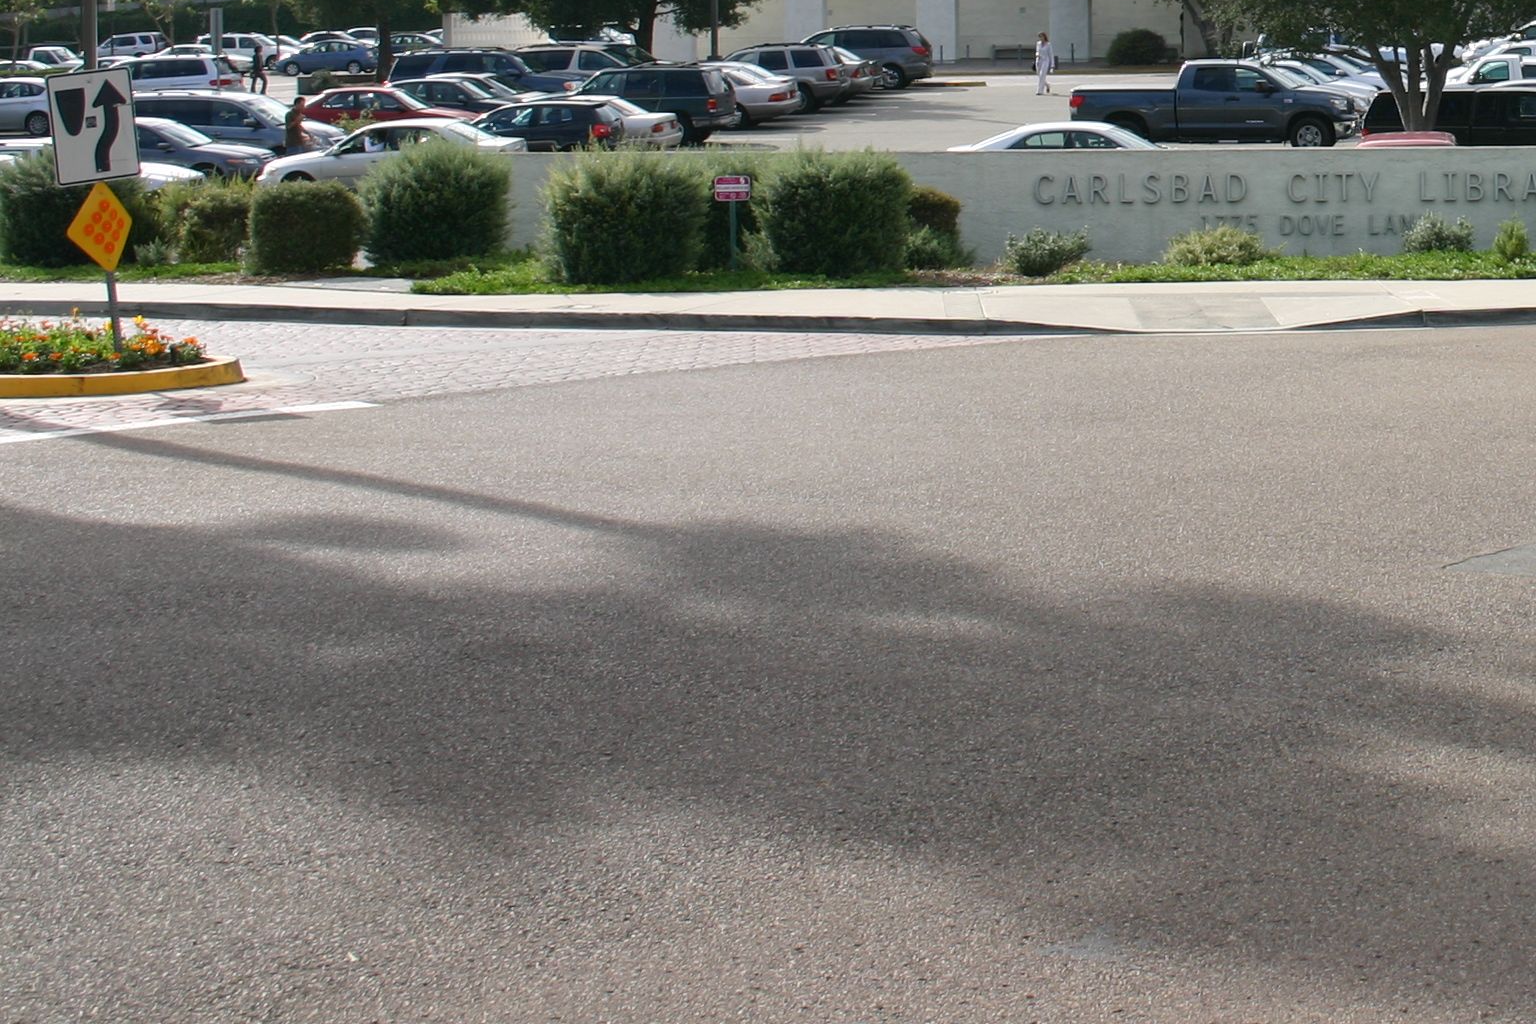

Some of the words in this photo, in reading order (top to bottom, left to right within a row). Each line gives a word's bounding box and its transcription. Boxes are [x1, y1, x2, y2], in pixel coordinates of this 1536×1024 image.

[1033, 173, 1248, 206] CARLSBAD
[1287, 173, 1381, 204] CITY
[1279, 214, 1345, 237] DOVE
[1367, 214, 1415, 237] LAN
